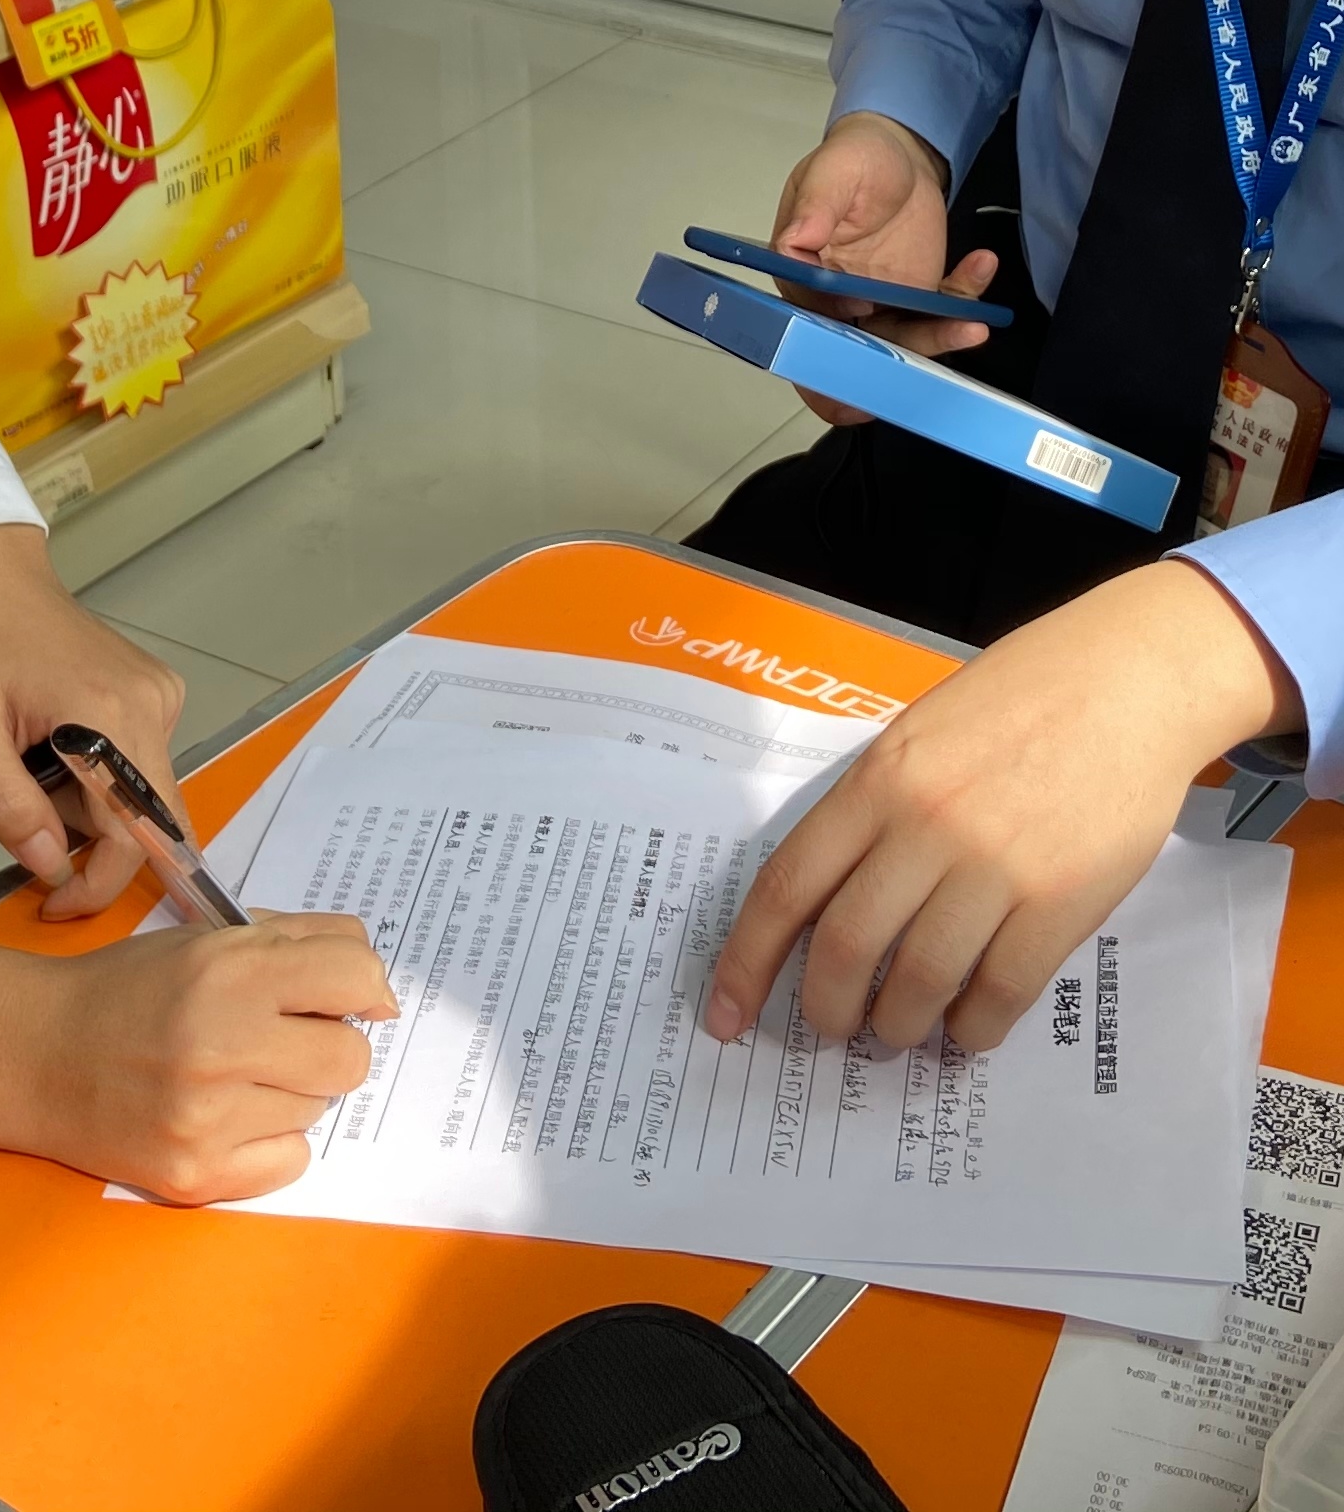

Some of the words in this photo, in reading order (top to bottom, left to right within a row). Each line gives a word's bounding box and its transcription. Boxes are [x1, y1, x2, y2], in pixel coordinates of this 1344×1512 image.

[37, 85, 146, 257] 静心
[164, 133, 283, 209] 助眠口服液
[1053, 977, 1082, 1047] 现场笔录
[1097, 936, 1120, 1095] 佛山市顺德区市场监督管理局
[574, 1422, 742, 1512] Canon
[1090, 1493, 1124, 1511] 30.00
[1093, 1483, 1120, 1498] 0.00
[1096, 1470, 1130, 1488] 30.00
